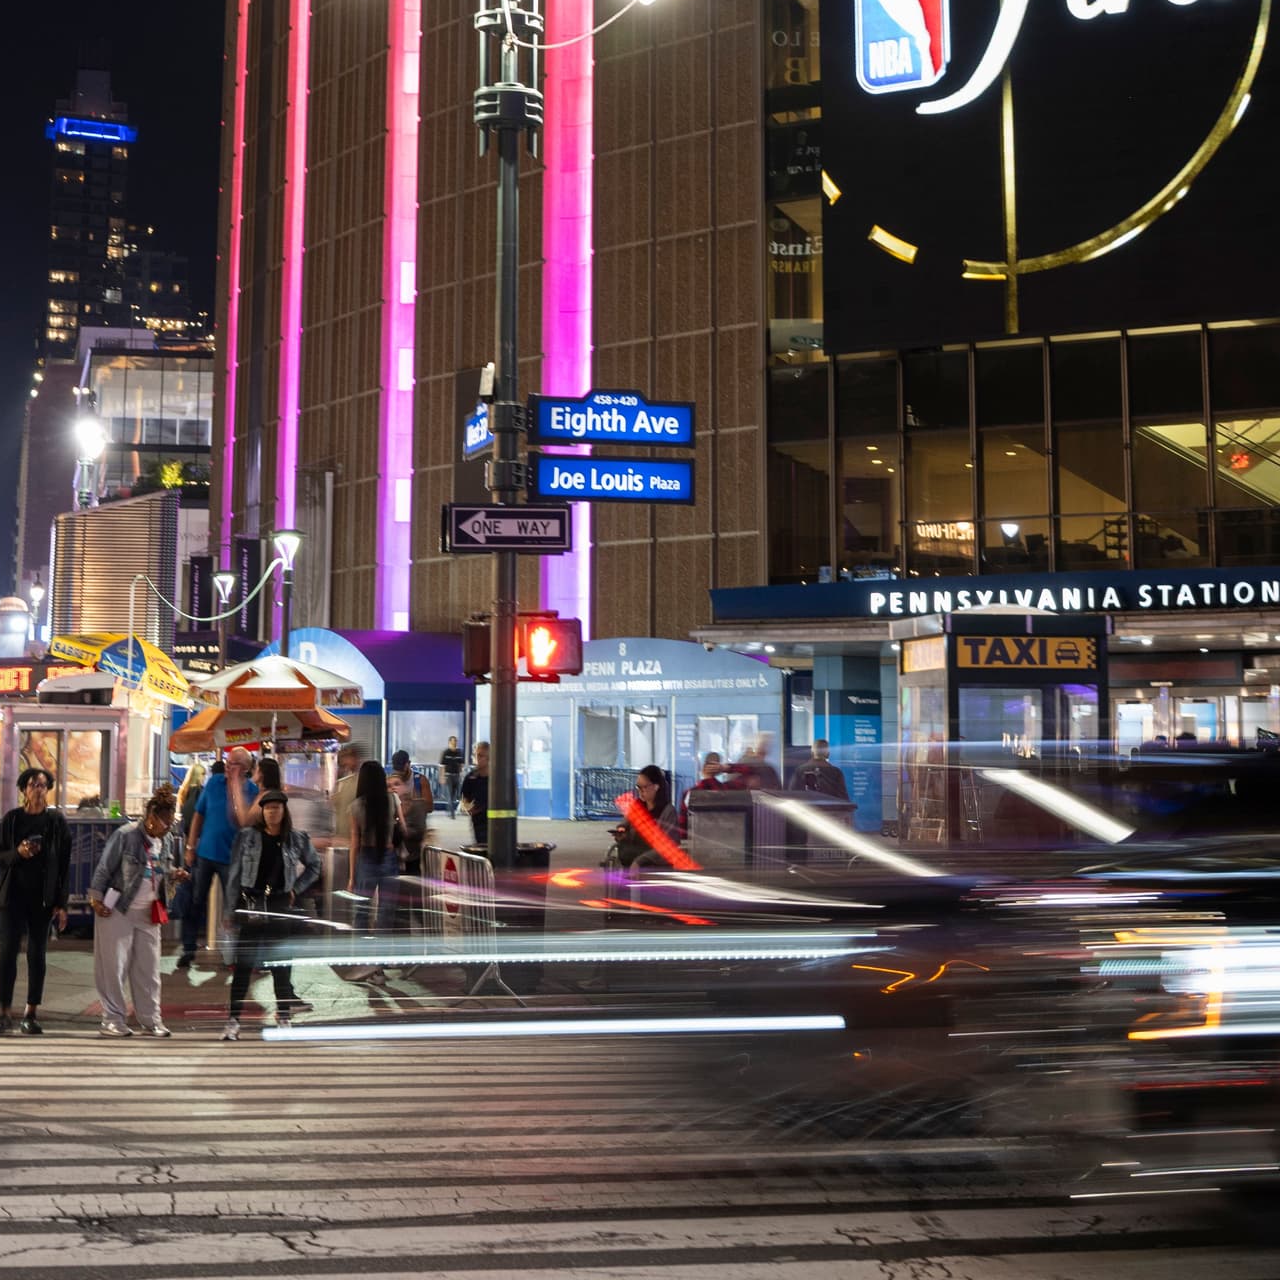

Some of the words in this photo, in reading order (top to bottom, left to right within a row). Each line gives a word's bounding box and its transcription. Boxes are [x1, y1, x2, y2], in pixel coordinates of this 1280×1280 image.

[869, 37, 913, 79] NBA
[551, 407, 626, 437] Eighth
[633, 410, 679, 435] Ave
[550, 467, 585, 489] Joe
[591, 468, 643, 492] Louis
[650, 476, 681, 491] Plaza
[471, 520, 501, 535] ONE
[517, 520, 551, 535] WAY
[1139, 581, 1280, 608] STATION
[619, 643, 626, 655] 8
[964, 638, 1048, 665] TAXI
[585, 662, 615, 676] PENN
[622, 660, 662, 675] PLAZA
